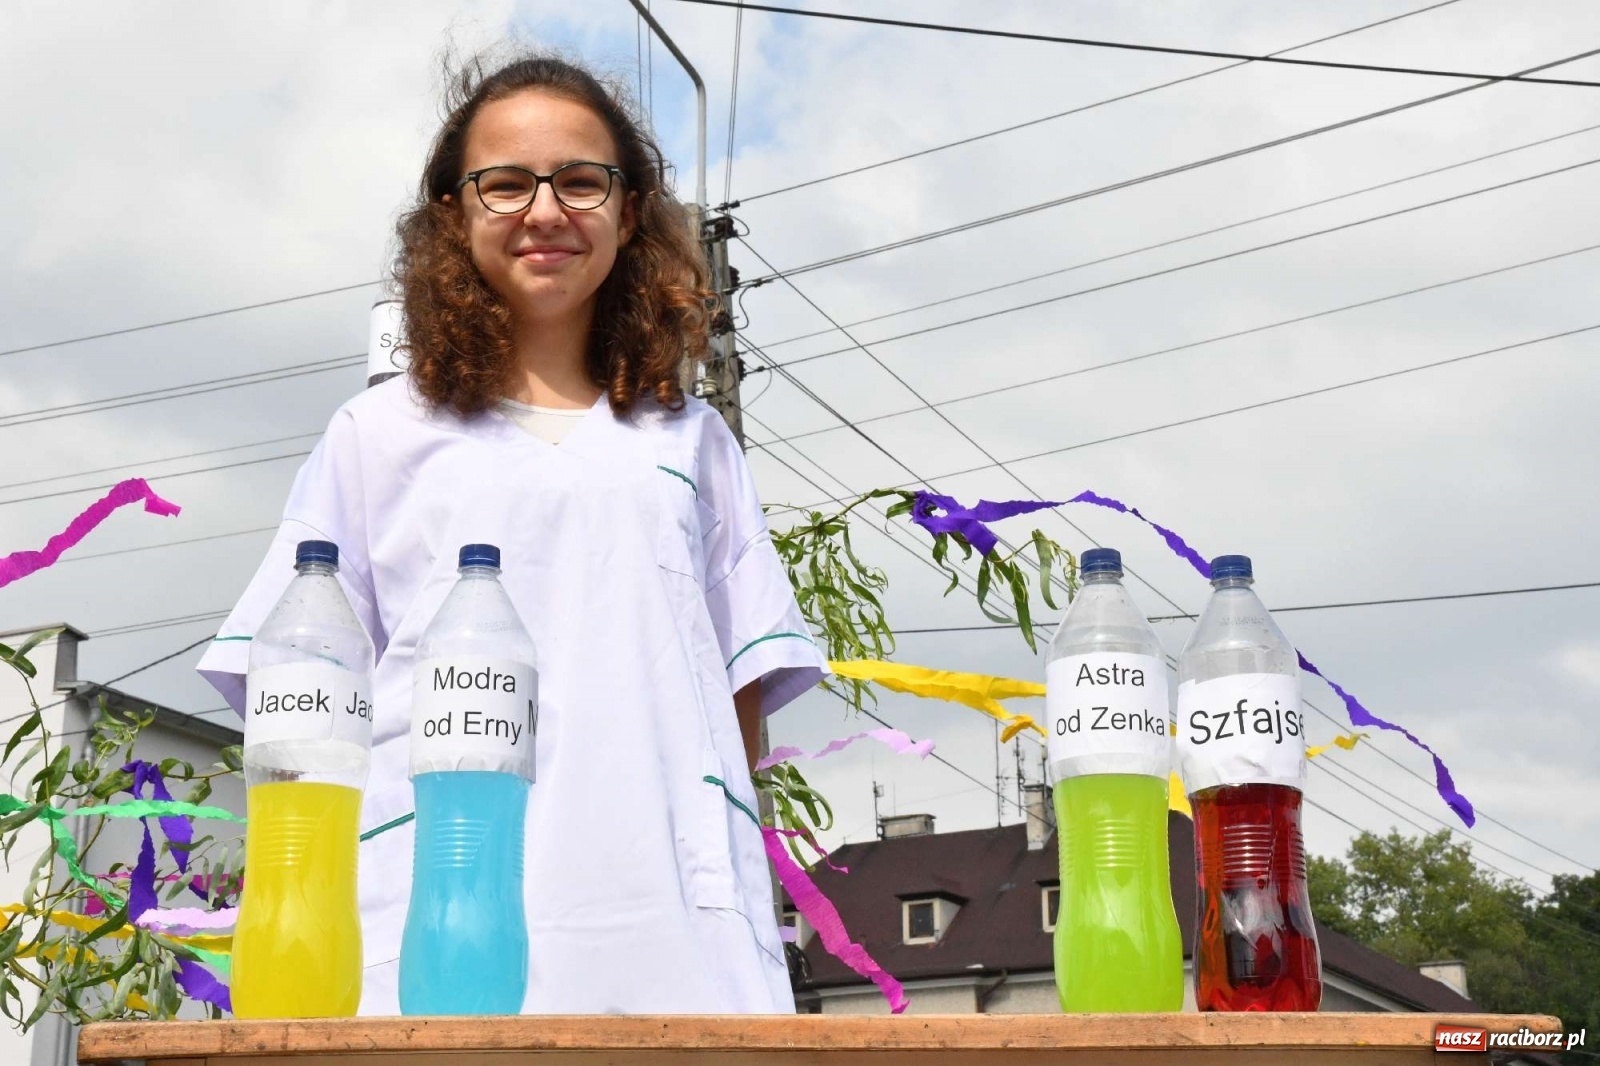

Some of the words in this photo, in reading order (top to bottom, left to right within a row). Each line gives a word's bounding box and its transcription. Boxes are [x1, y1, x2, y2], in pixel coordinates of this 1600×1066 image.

[434, 666, 516, 693] Modra
[1076, 662, 1145, 687] Astra
[254, 688, 330, 716] Jacek
[424, 711, 451, 738] od
[463, 711, 522, 746] Erny
[1056, 708, 1080, 736] od
[1090, 706, 1165, 736] Zenka
